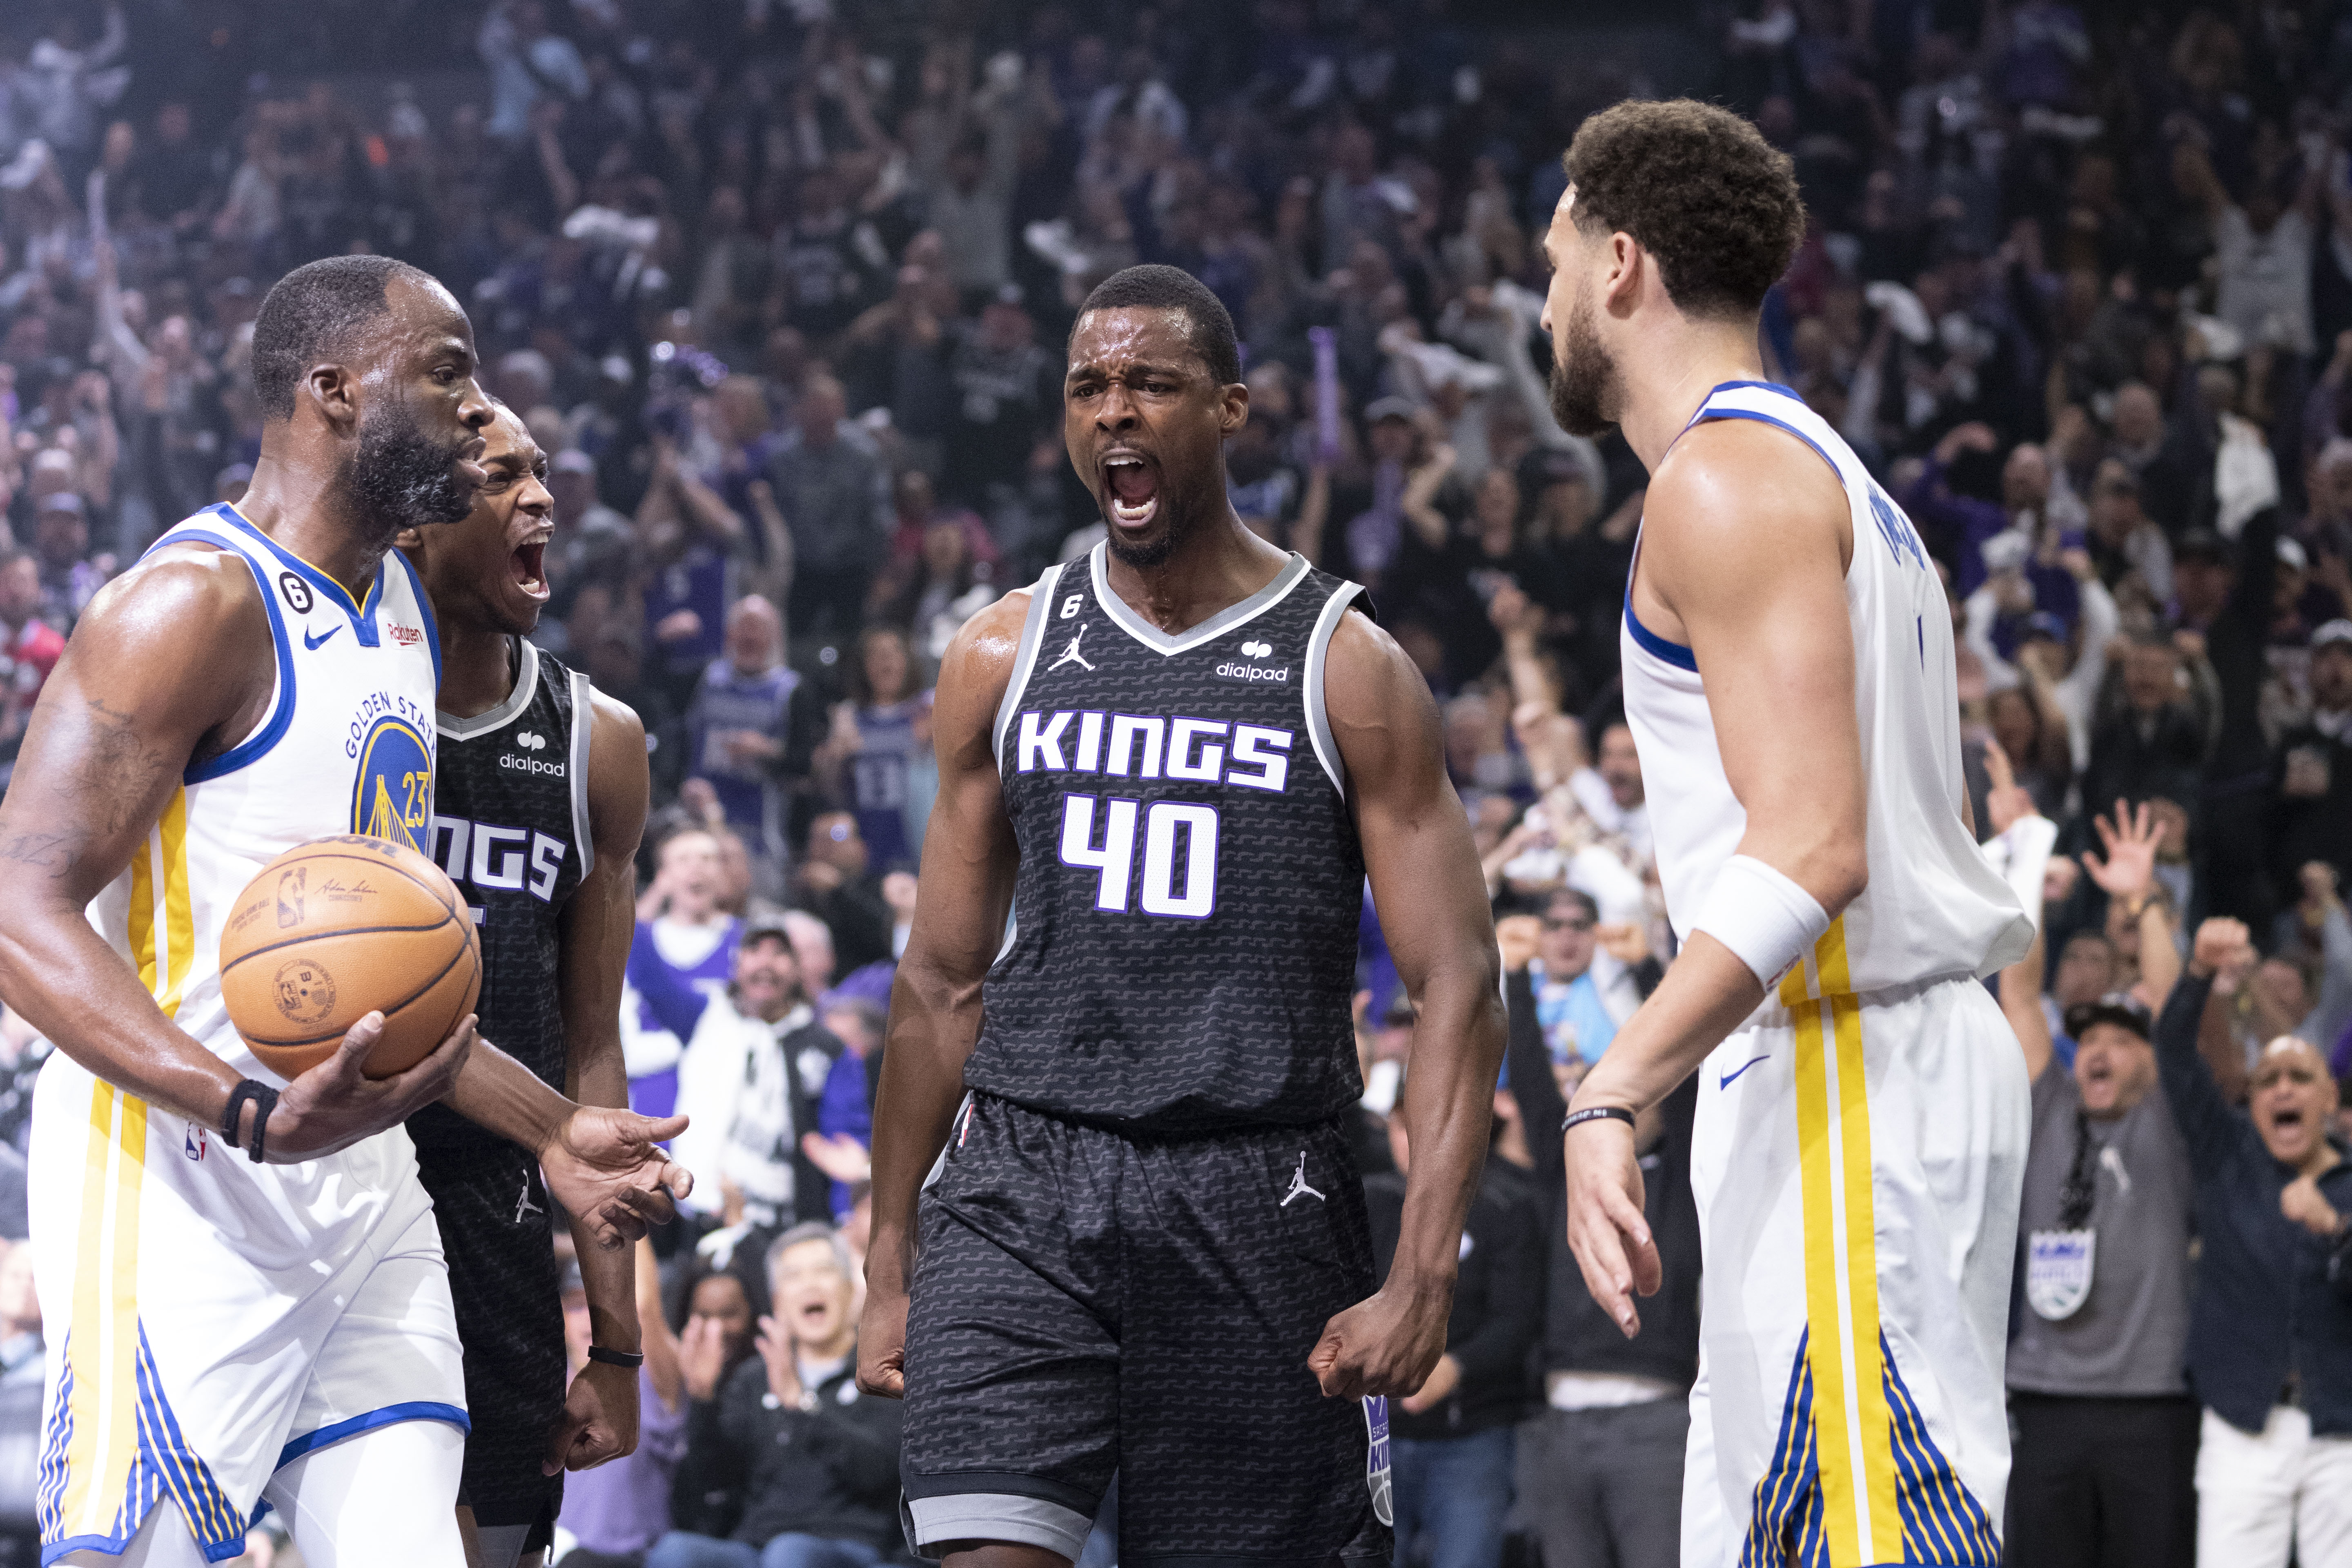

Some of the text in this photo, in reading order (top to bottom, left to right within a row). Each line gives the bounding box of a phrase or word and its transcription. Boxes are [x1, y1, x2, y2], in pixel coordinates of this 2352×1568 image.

[283, 577, 309, 609] 6
[1060, 594, 1084, 619] 6
[388, 623, 423, 642] Rakuten
[1216, 662, 1288, 682] dialpad
[346, 691, 392, 759] GOLDEN
[500, 753, 564, 777] dialpad
[1017, 710, 1295, 794] KINGS
[402, 771, 429, 828] 23
[428, 813, 568, 904] NGS
[1058, 791, 1221, 920] 40
[1370, 1441, 1390, 1474] KIN
